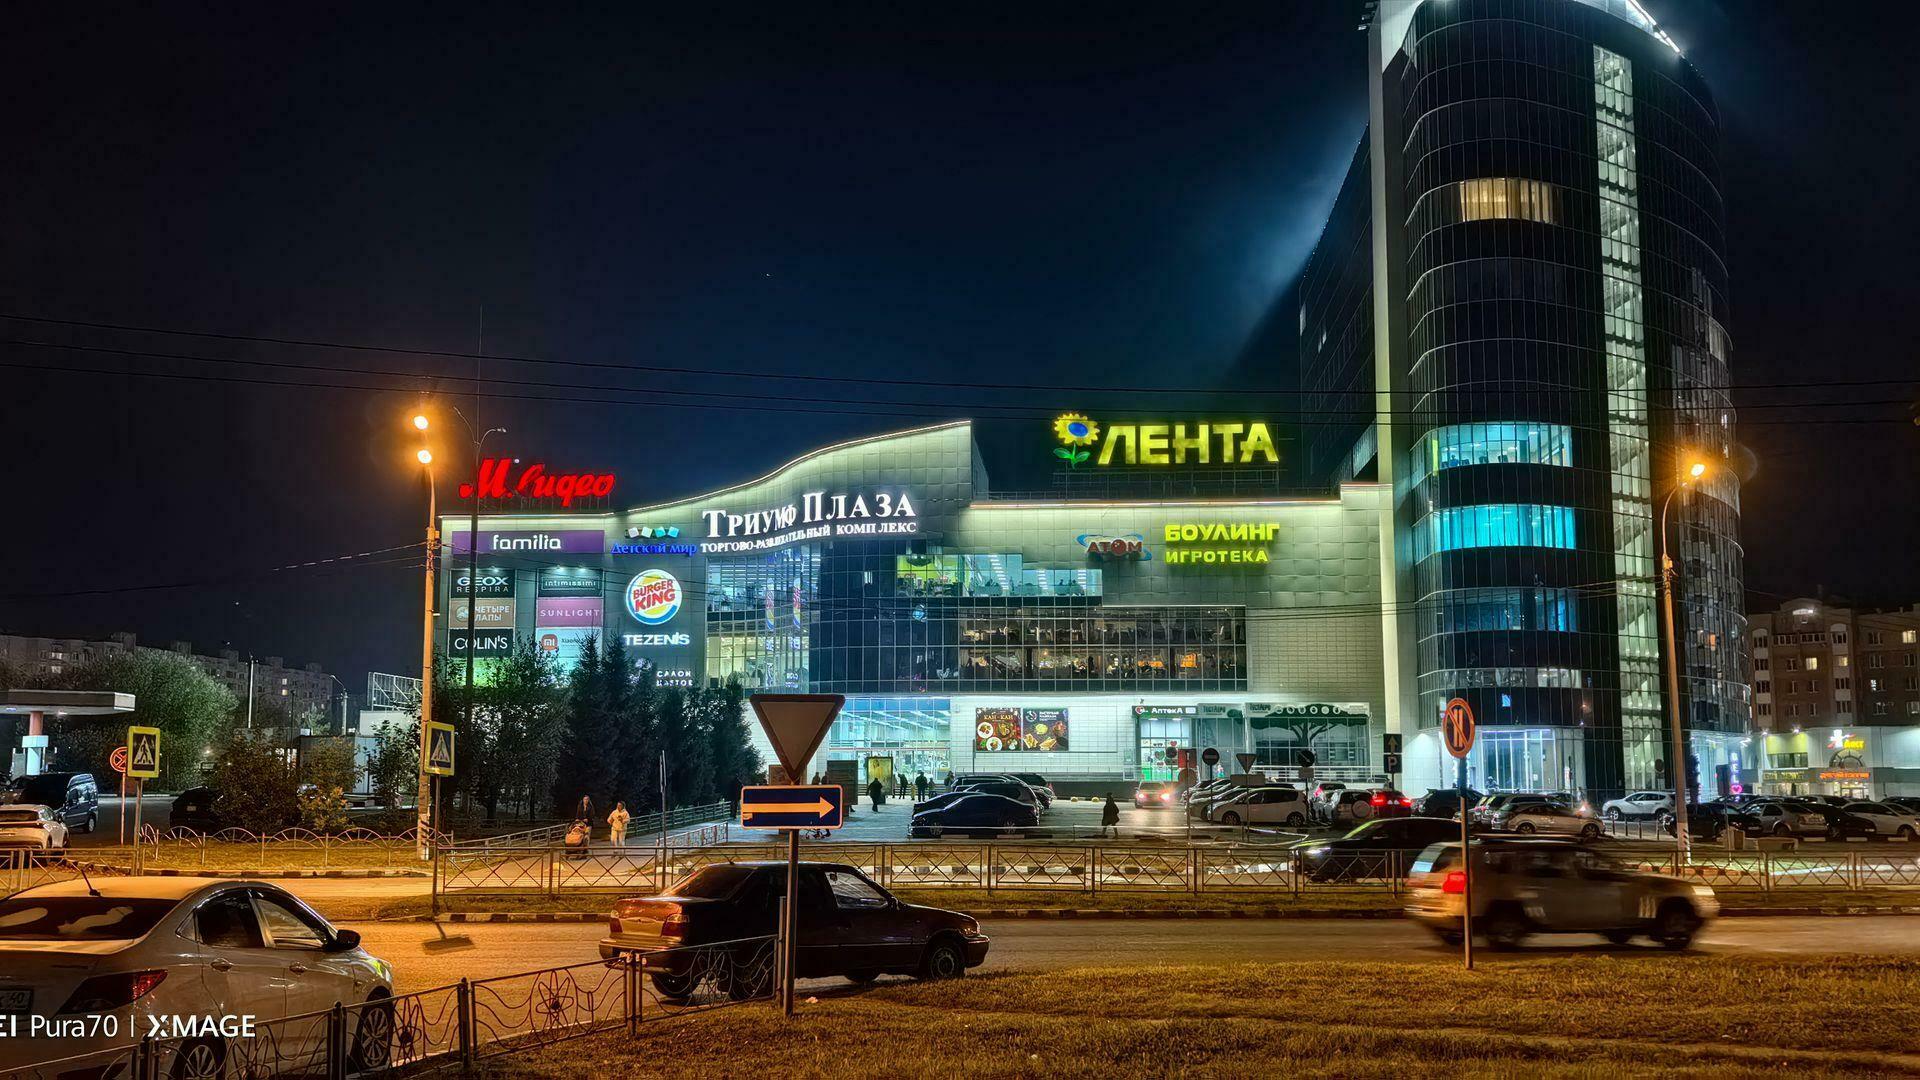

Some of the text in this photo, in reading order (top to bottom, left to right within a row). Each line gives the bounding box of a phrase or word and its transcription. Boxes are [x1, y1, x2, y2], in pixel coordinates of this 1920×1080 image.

[1098, 423, 1279, 465] ЛЕНТА
[1164, 523, 1280, 542] БОУЛИНГ
[493, 534, 562, 550] familia
[669, 544, 698, 557] мир
[1166, 549, 1268, 564] ИГРОТЕКА
[457, 576, 509, 586] GEOX
[633, 579, 674, 600] BURGER
[635, 588, 676, 612] KING
[540, 609, 600, 617] SUNLIGHT
[454, 635, 508, 650] COLIN'S
[657, 670, 691, 678] САЛОН
